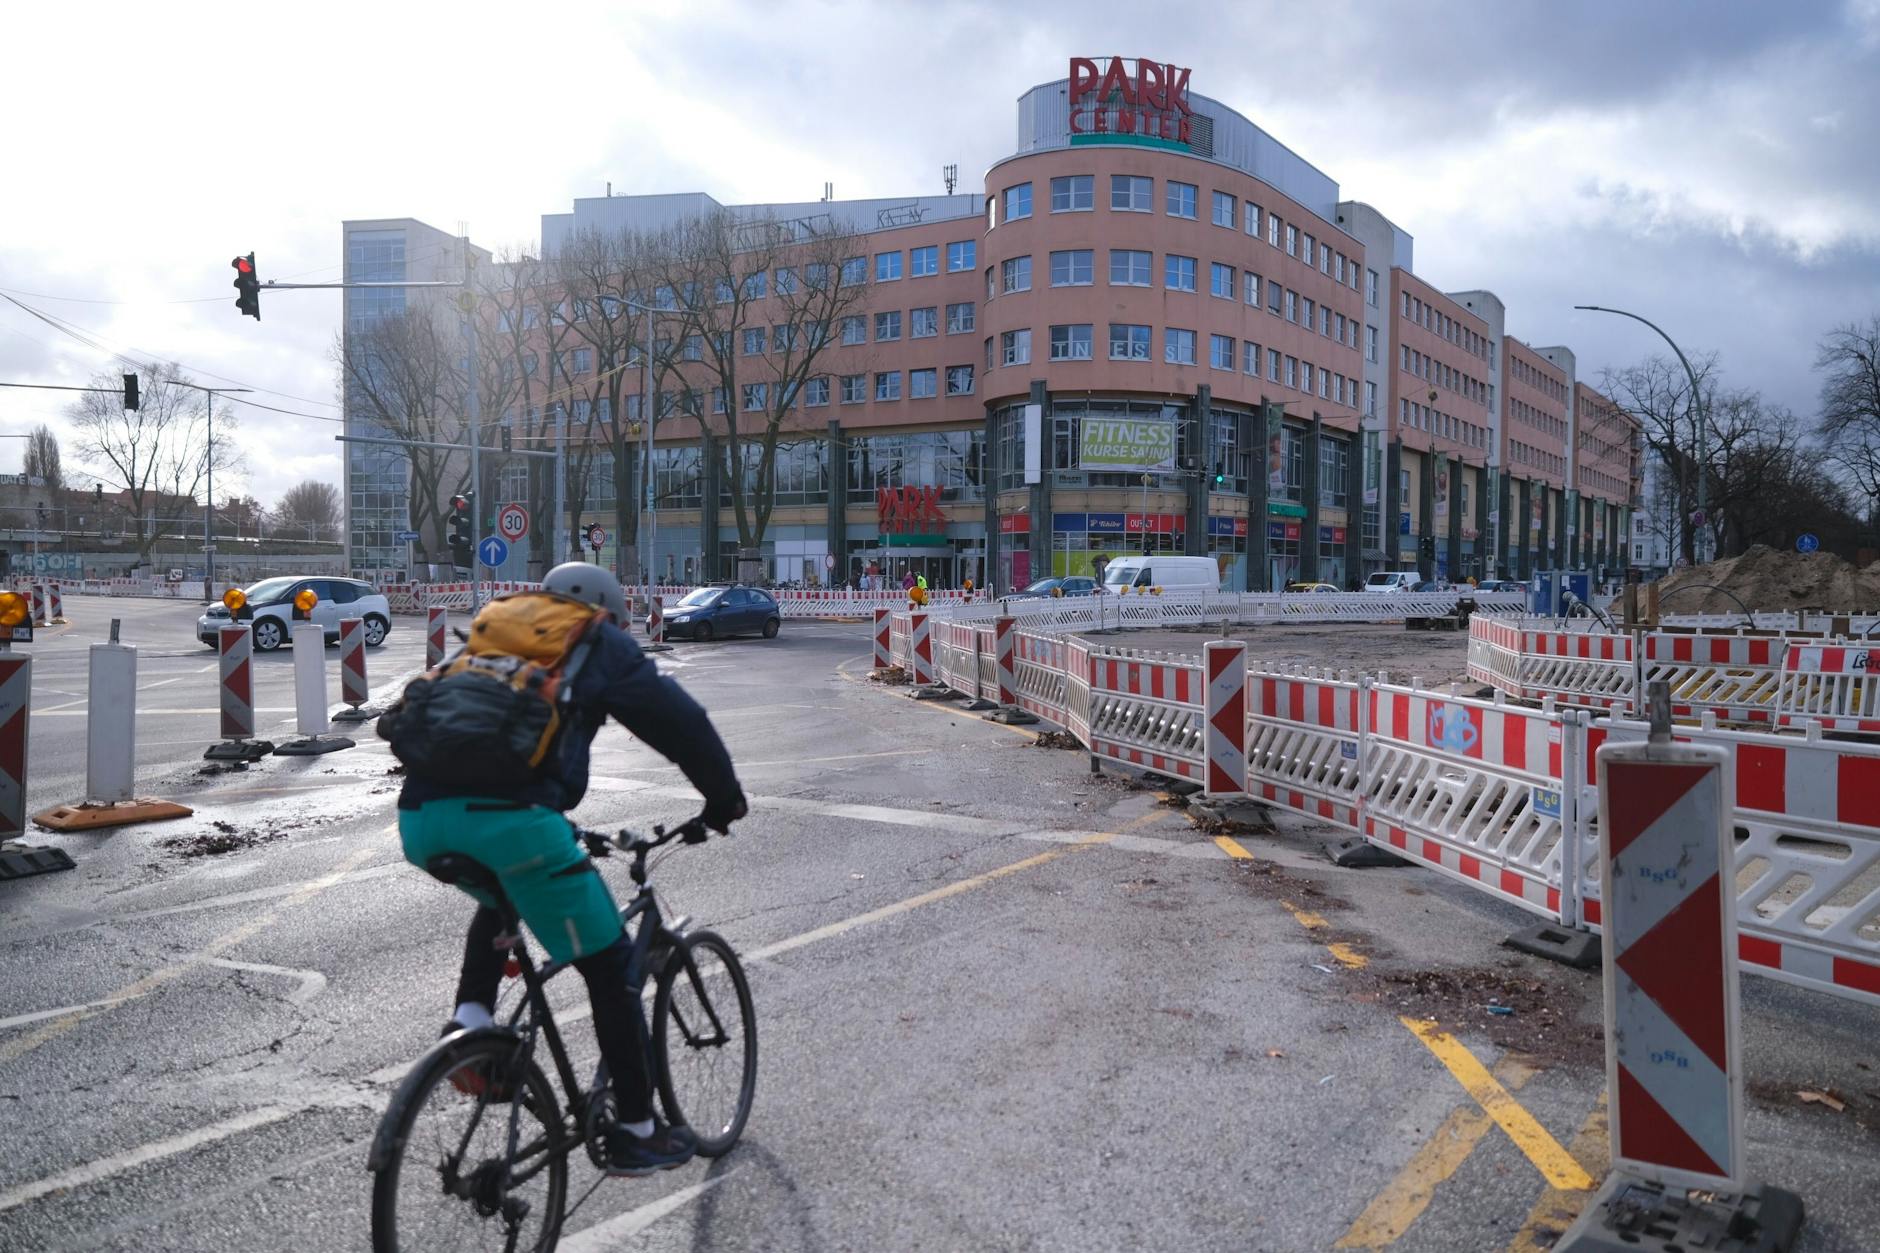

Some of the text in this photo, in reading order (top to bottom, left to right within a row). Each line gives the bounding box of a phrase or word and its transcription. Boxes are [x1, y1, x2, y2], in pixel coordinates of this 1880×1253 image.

[1069, 56, 1195, 117] PARK
[1069, 107, 1192, 144] CENTER
[1083, 421, 1171, 446] FITNESS
[1083, 444, 1170, 460] KURSE SAUNA
[878, 484, 945, 519] PARK
[504, 515, 522, 530] 30
[593, 531, 604, 541] 30
[1537, 790, 1558, 808] BSG
[1640, 867, 1677, 883] BSG
[1650, 1049, 1688, 1068] BSG
